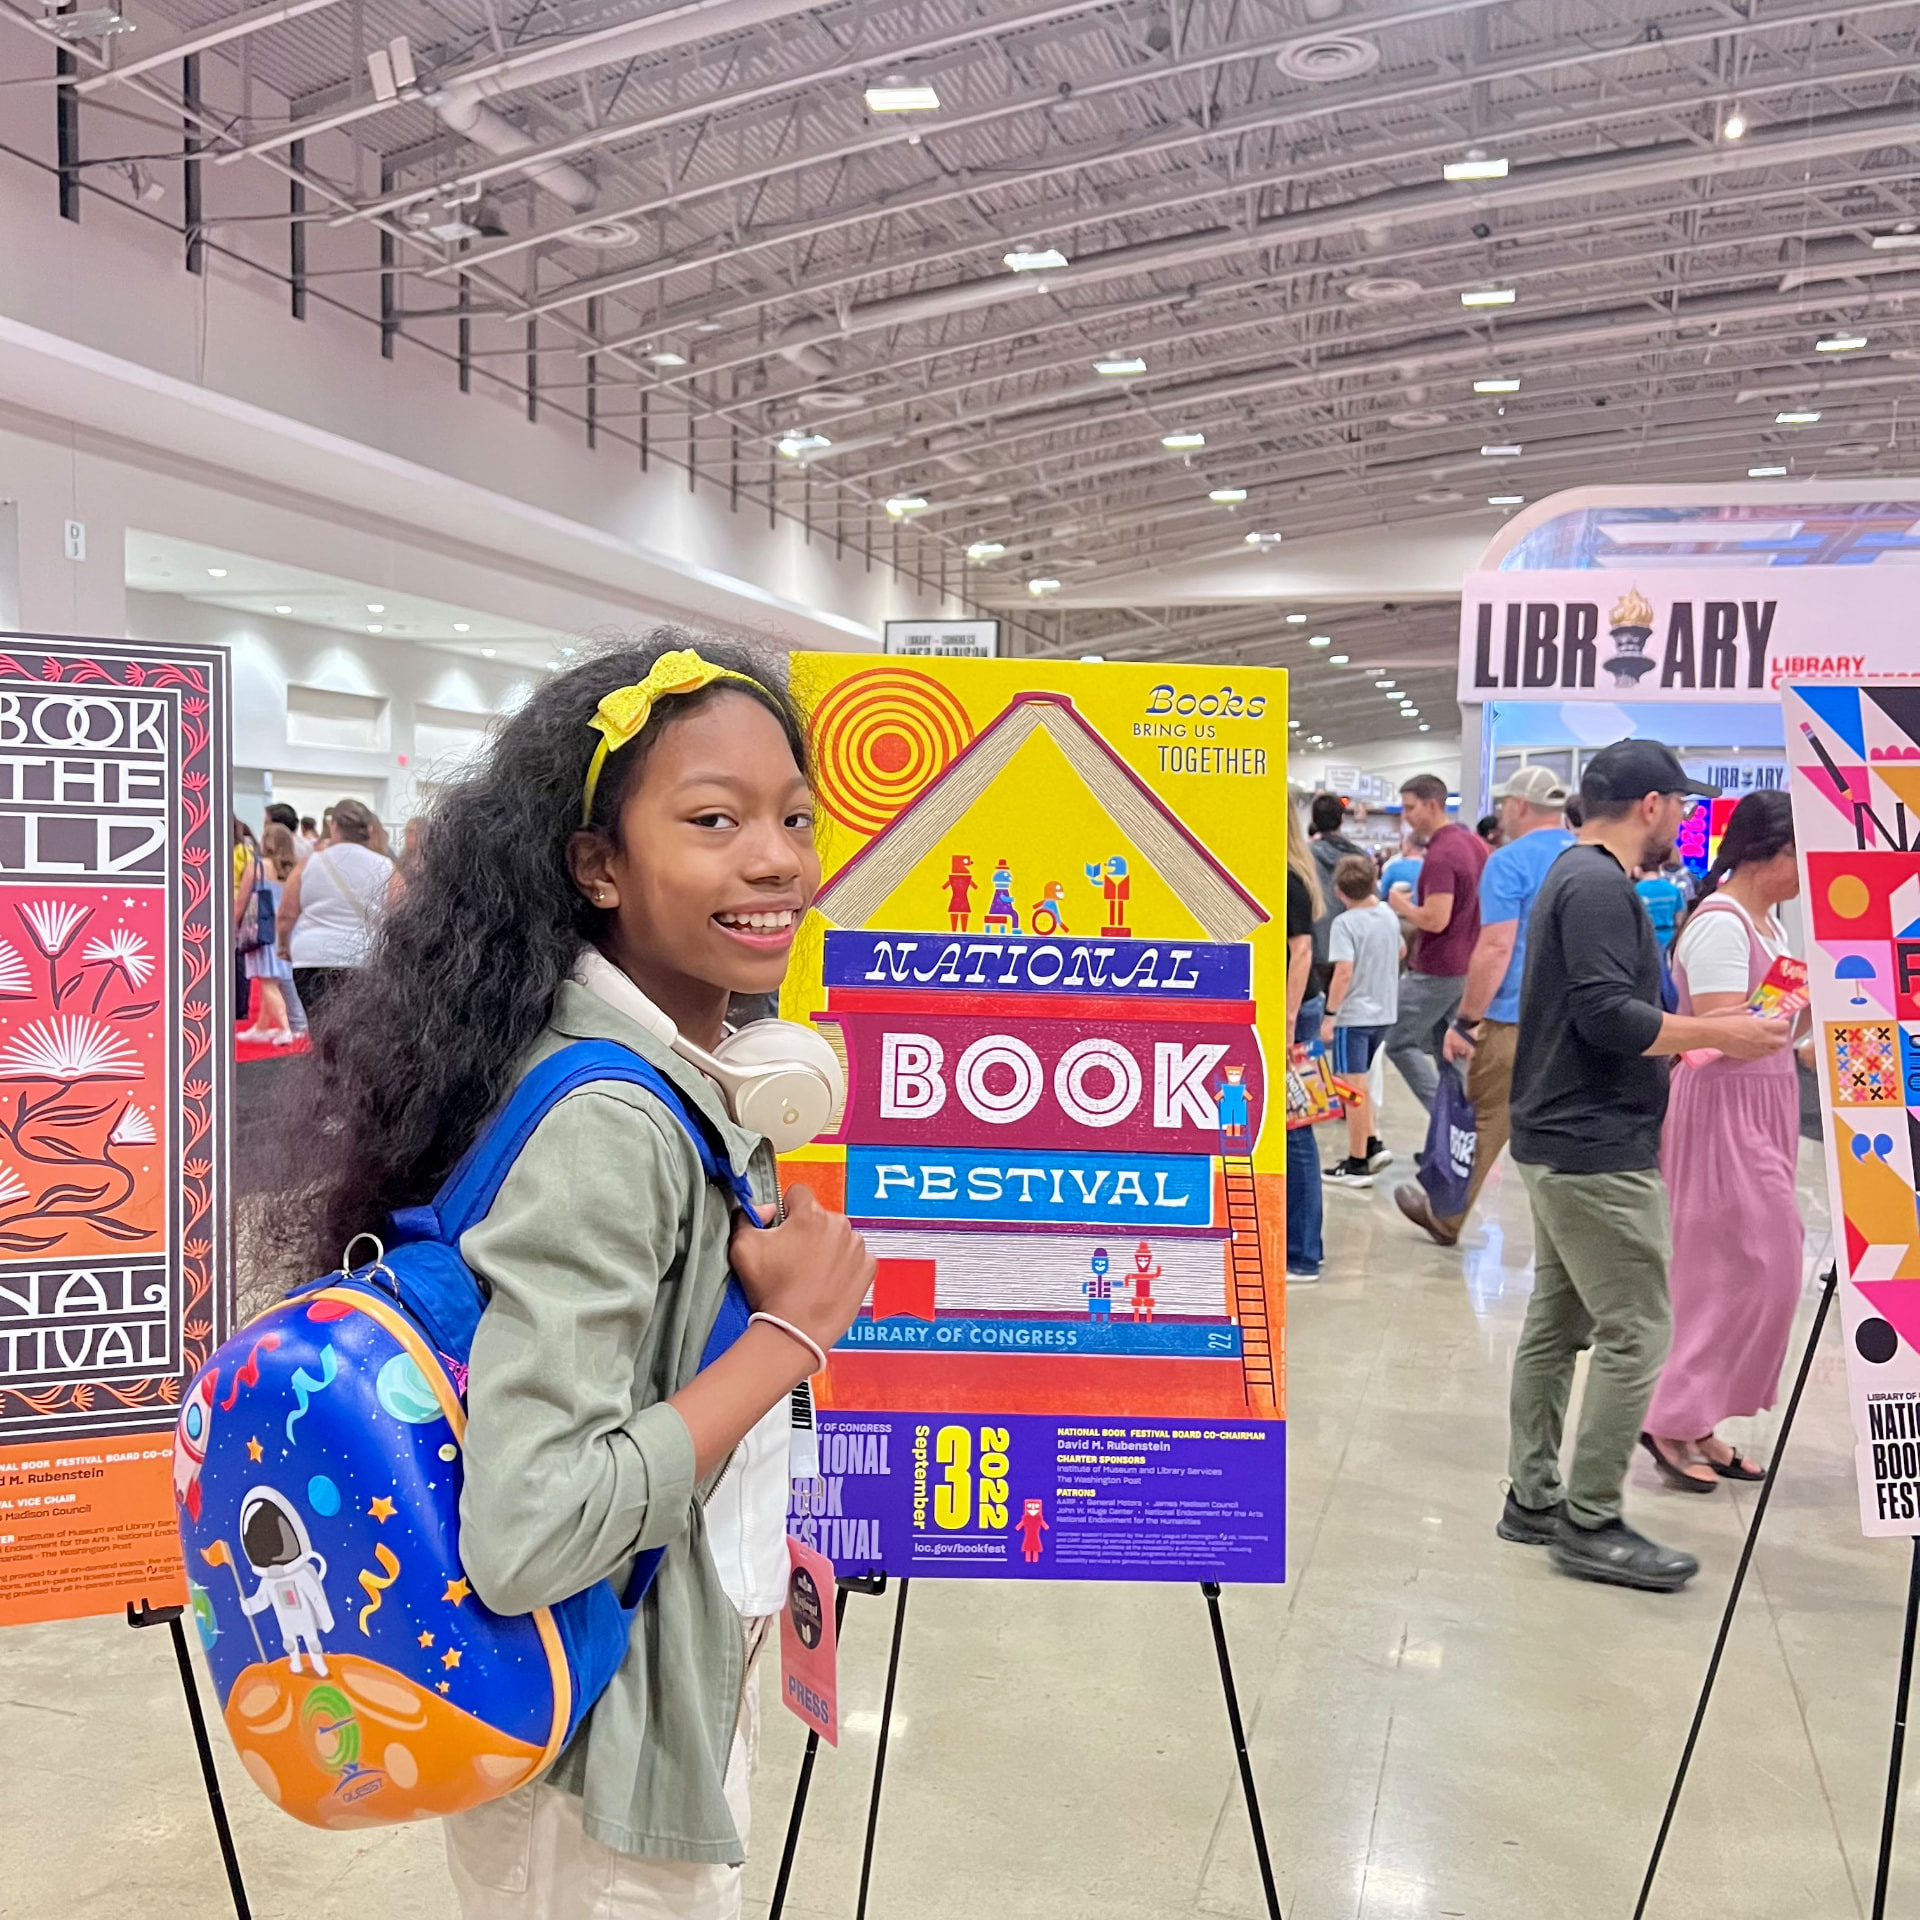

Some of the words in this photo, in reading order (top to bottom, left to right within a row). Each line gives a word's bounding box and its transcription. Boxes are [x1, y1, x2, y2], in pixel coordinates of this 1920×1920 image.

[1771, 655, 1865, 673] LIBRARY
[1145, 684, 1266, 718] Books
[0, 694, 164, 752] BOOK
[1132, 722, 1190, 738] BRING
[1193, 723, 1216, 739] US
[1158, 745, 1267, 776] TOGETHER
[0, 757, 165, 806] THE
[864, 940, 1199, 990] NATIONAL
[879, 1032, 1232, 1131] BOOK
[874, 1164, 1189, 1208] FESTIVAL
[847, 1325, 928, 1343] LIBRARY
[936, 1327, 964, 1344] OF
[969, 1328, 1078, 1346] CONGRESS
[1208, 1333, 1231, 1349] 22
[1867, 1392, 1904, 1401] LIBRARY
[1905, 1392, 1917, 1400] OF
[824, 1423, 837, 1431] OF
[838, 1423, 892, 1433] CONGRESS
[1057, 1428, 1100, 1437] NATIONAL
[1102, 1429, 1126, 1437] BOOK
[1130, 1429, 1170, 1438] FESTIVAL
[1172, 1430, 1202, 1439] BOARD
[1203, 1431, 1266, 1440] CO-CHAIRMAN
[1057, 1440, 1089, 1450] David
[1092, 1441, 1104, 1450] M.
[1107, 1441, 1171, 1451] Rubenstein
[21, 1459, 51, 1471] BOOK
[56, 1455, 103, 1468] FESTIVAL
[106, 1452, 140, 1463] BOARD
[1057, 1455, 1098, 1464] CHARTER
[1099, 1456, 1146, 1465] SPONSORS
[9, 1475, 24, 1486] M.
[28, 1468, 104, 1484] Rubenstein
[912, 1425, 930, 1530] September
[933, 1424, 972, 1530] 3
[978, 1426, 1010, 1529] 2022
[1139, 1466, 1155, 1475] and
[1157, 1467, 1185, 1477] Library
[17, 1496, 42, 1507] VICE
[44, 1493, 77, 1504] CHAIR
[786, 1476, 844, 1517] OOK
[1056, 1489, 1096, 1498] PATRONS
[5, 1509, 50, 1521] Madison
[52, 1504, 92, 1516] Council
[786, 1518, 883, 1560] ESTIVAL
[914, 1542, 1006, 1555] loc.gov/bookfest
[788, 1674, 829, 1725] PRESS
